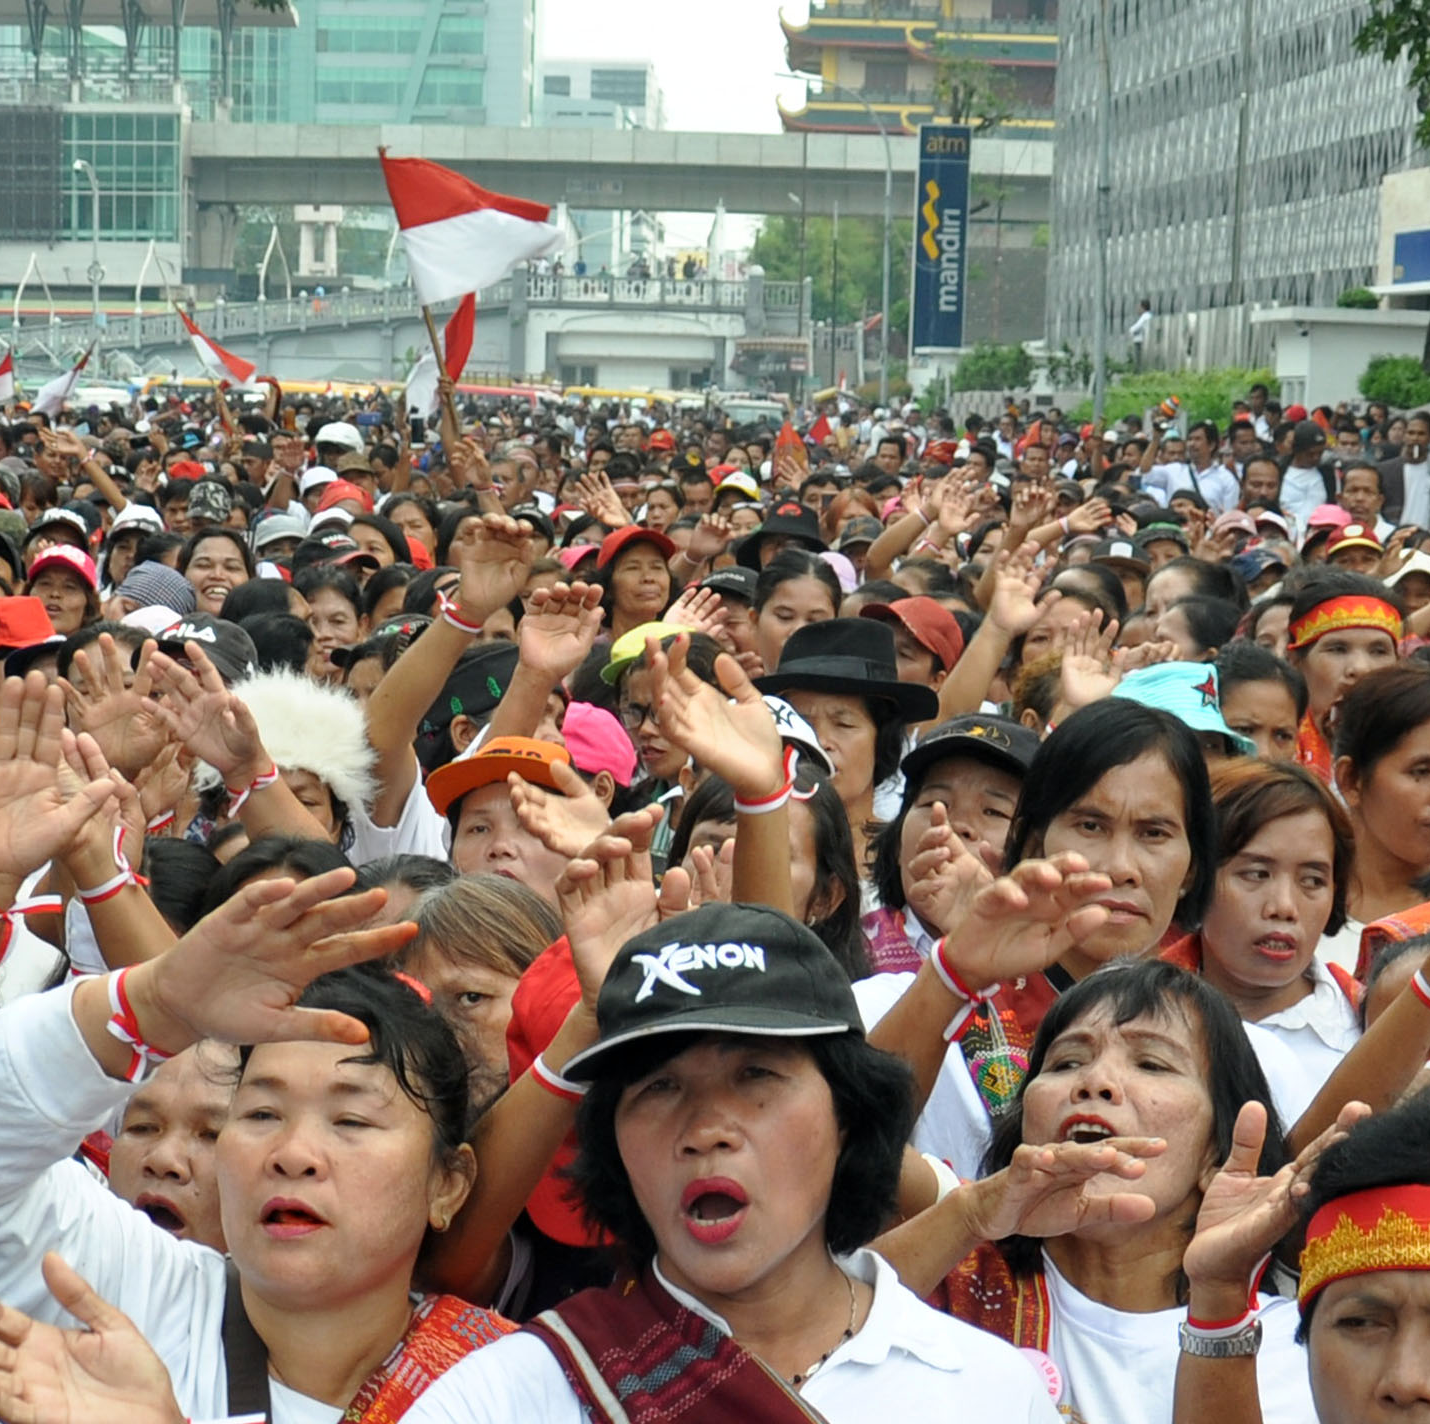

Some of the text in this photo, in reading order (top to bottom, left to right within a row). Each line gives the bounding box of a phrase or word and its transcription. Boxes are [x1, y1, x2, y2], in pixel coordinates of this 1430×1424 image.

[926, 135, 966, 153] atm
[936, 208, 961, 312] mandiri
[162, 620, 217, 643] FILA
